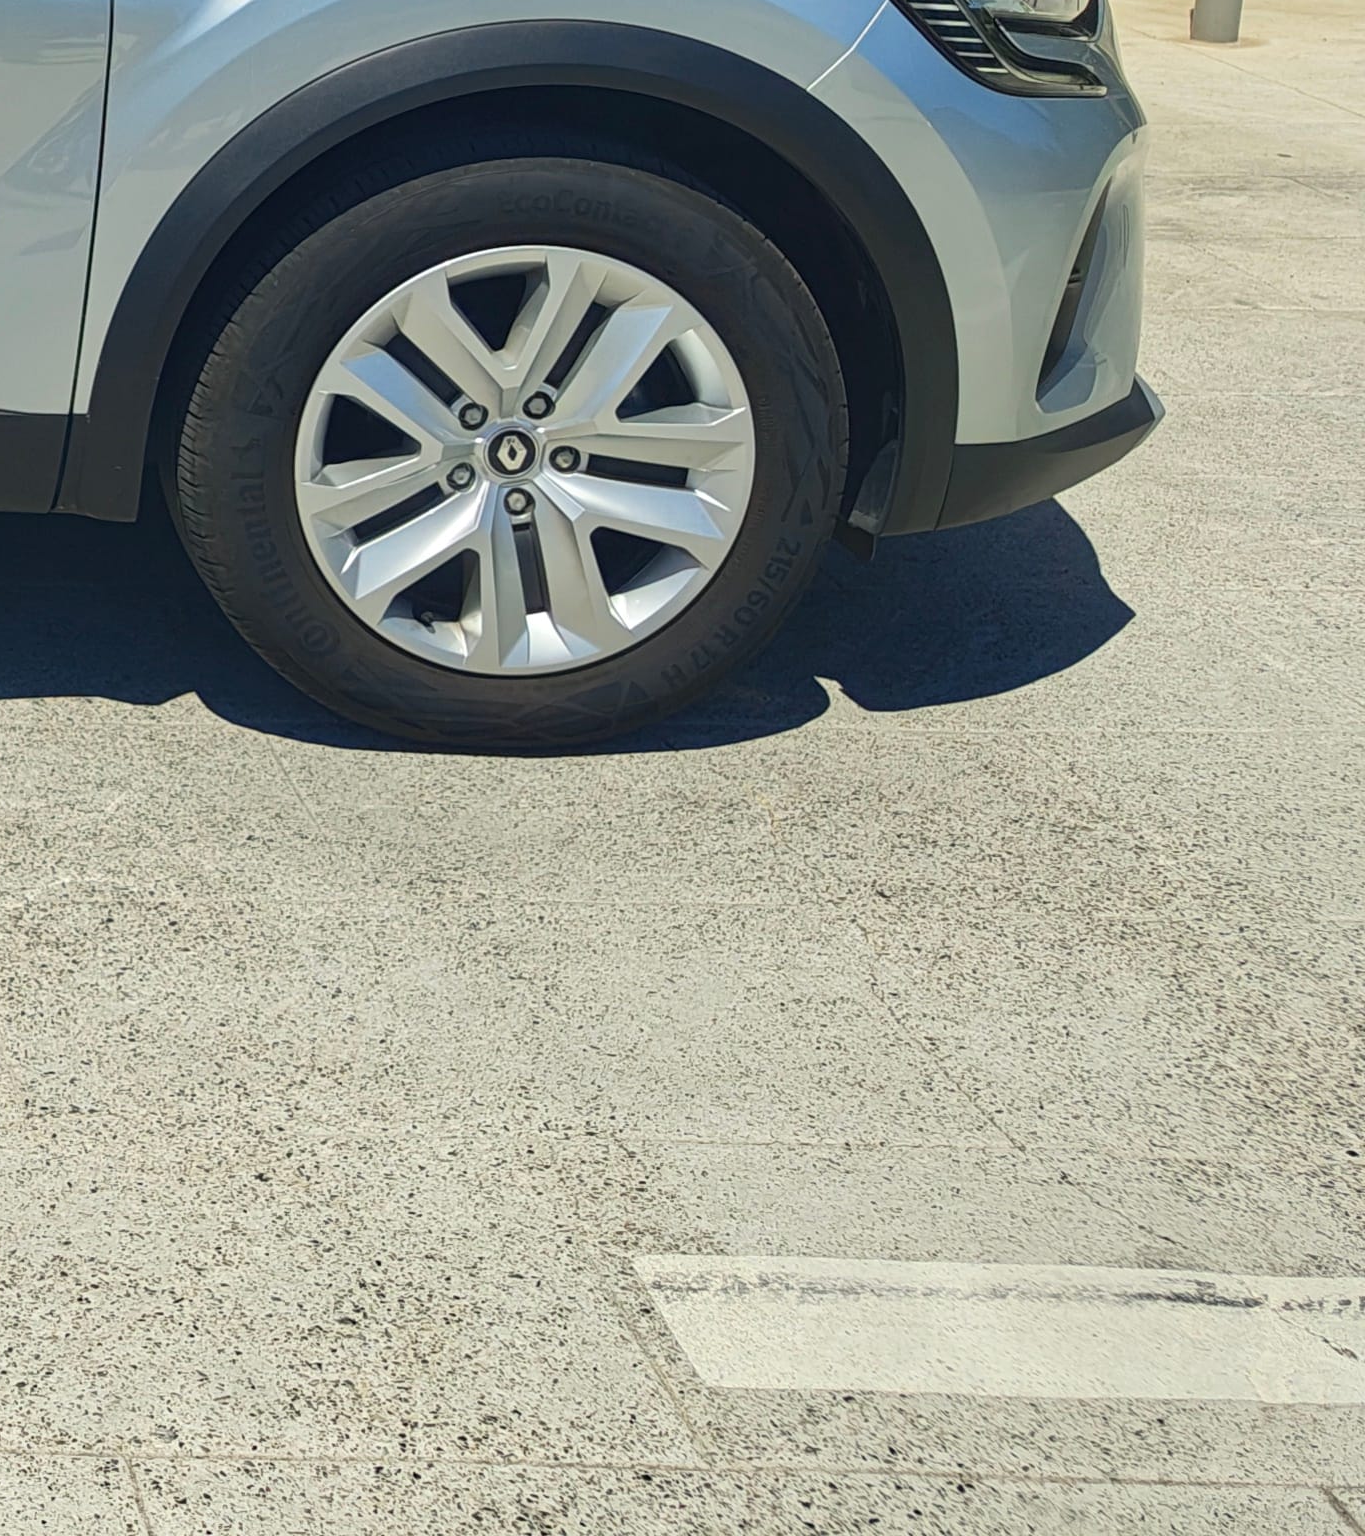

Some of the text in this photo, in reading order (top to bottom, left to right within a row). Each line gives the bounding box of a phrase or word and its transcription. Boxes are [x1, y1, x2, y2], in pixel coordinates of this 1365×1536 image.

[734, 536, 802, 626] 215/60
[715, 624, 740, 649] R
[689, 643, 719, 670] 17
